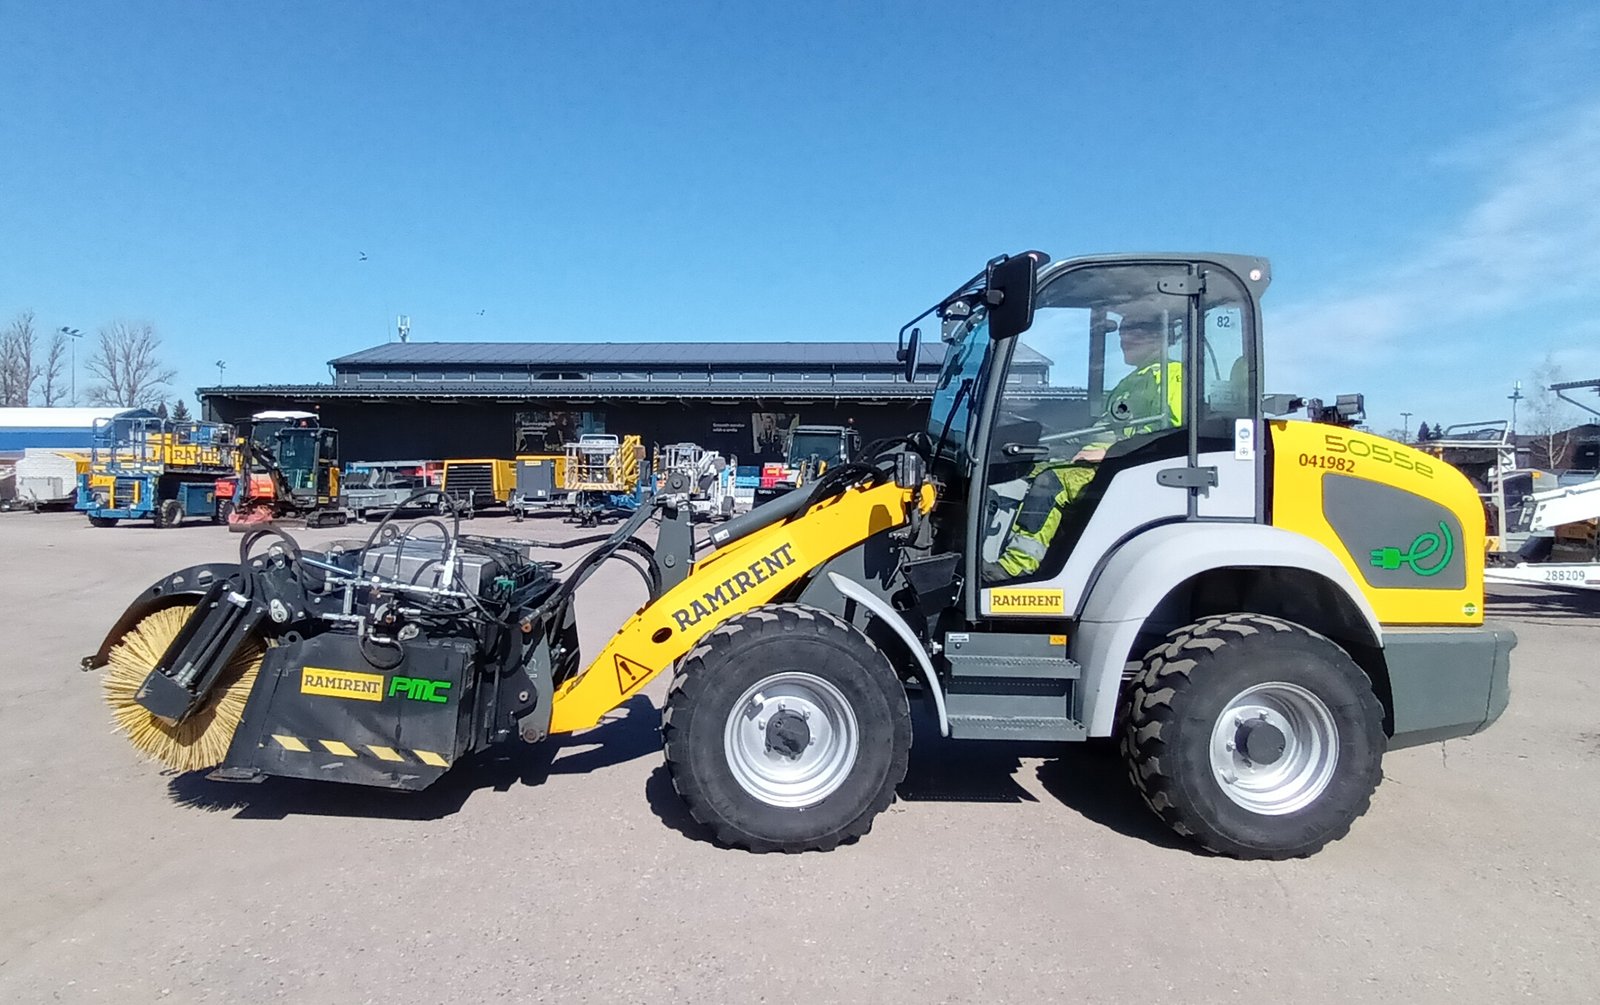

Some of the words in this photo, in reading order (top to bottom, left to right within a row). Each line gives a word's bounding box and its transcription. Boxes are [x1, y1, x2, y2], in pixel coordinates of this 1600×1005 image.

[1217, 315, 1230, 328] 82
[1299, 453, 1356, 473] 041982
[1545, 570, 1586, 581] 288209
[671, 542, 796, 632] RAMIRENT
[992, 595, 1061, 607] RAMIRENT
[304, 674, 380, 694] RAMIRENT
[388, 676, 452, 703] PMC
